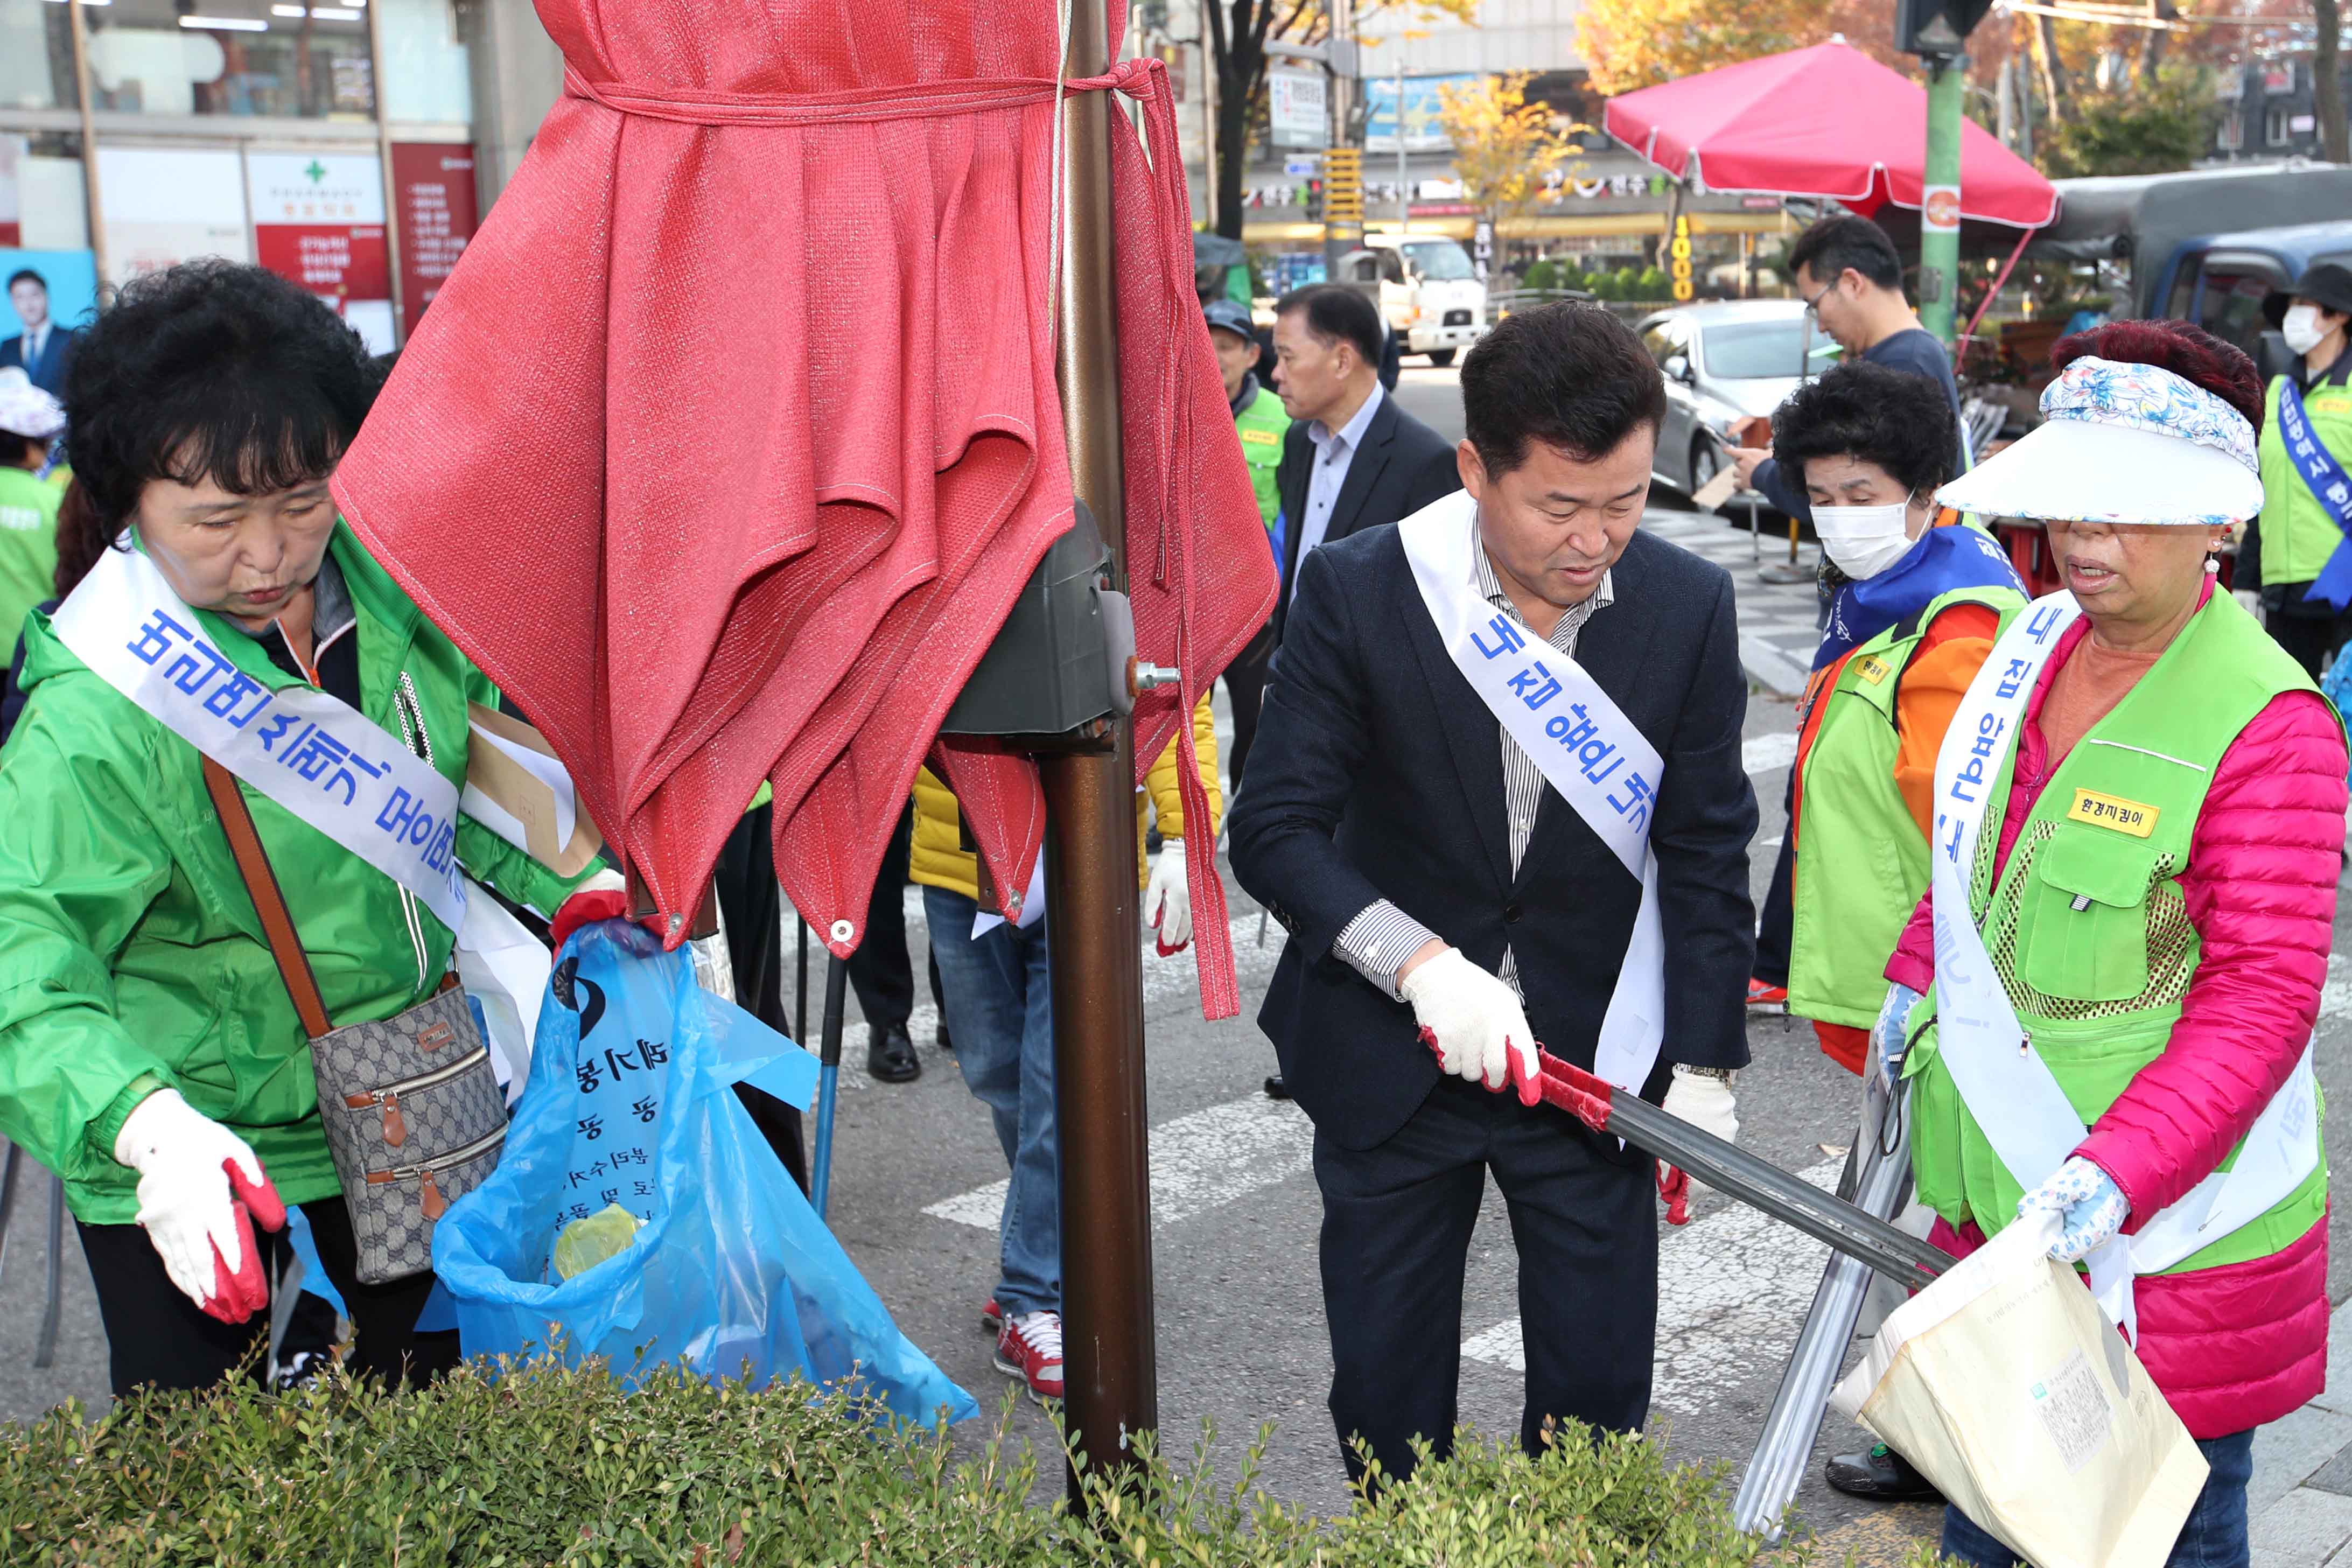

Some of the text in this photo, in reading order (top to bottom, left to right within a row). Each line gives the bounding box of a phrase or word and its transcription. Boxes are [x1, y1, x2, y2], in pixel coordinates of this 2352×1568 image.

[2026, 605, 2063, 645] 내
[1470, 613, 1527, 660] 내
[1507, 661, 1563, 711] 집
[1545, 703, 1626, 785] 앞은
[1995, 658, 2031, 699] 집
[126, 608, 274, 729] 버리면
[375, 786, 457, 871] 모으면
[1950, 712, 2004, 803] 앞은
[2081, 797, 2143, 827] 환경지킴이
